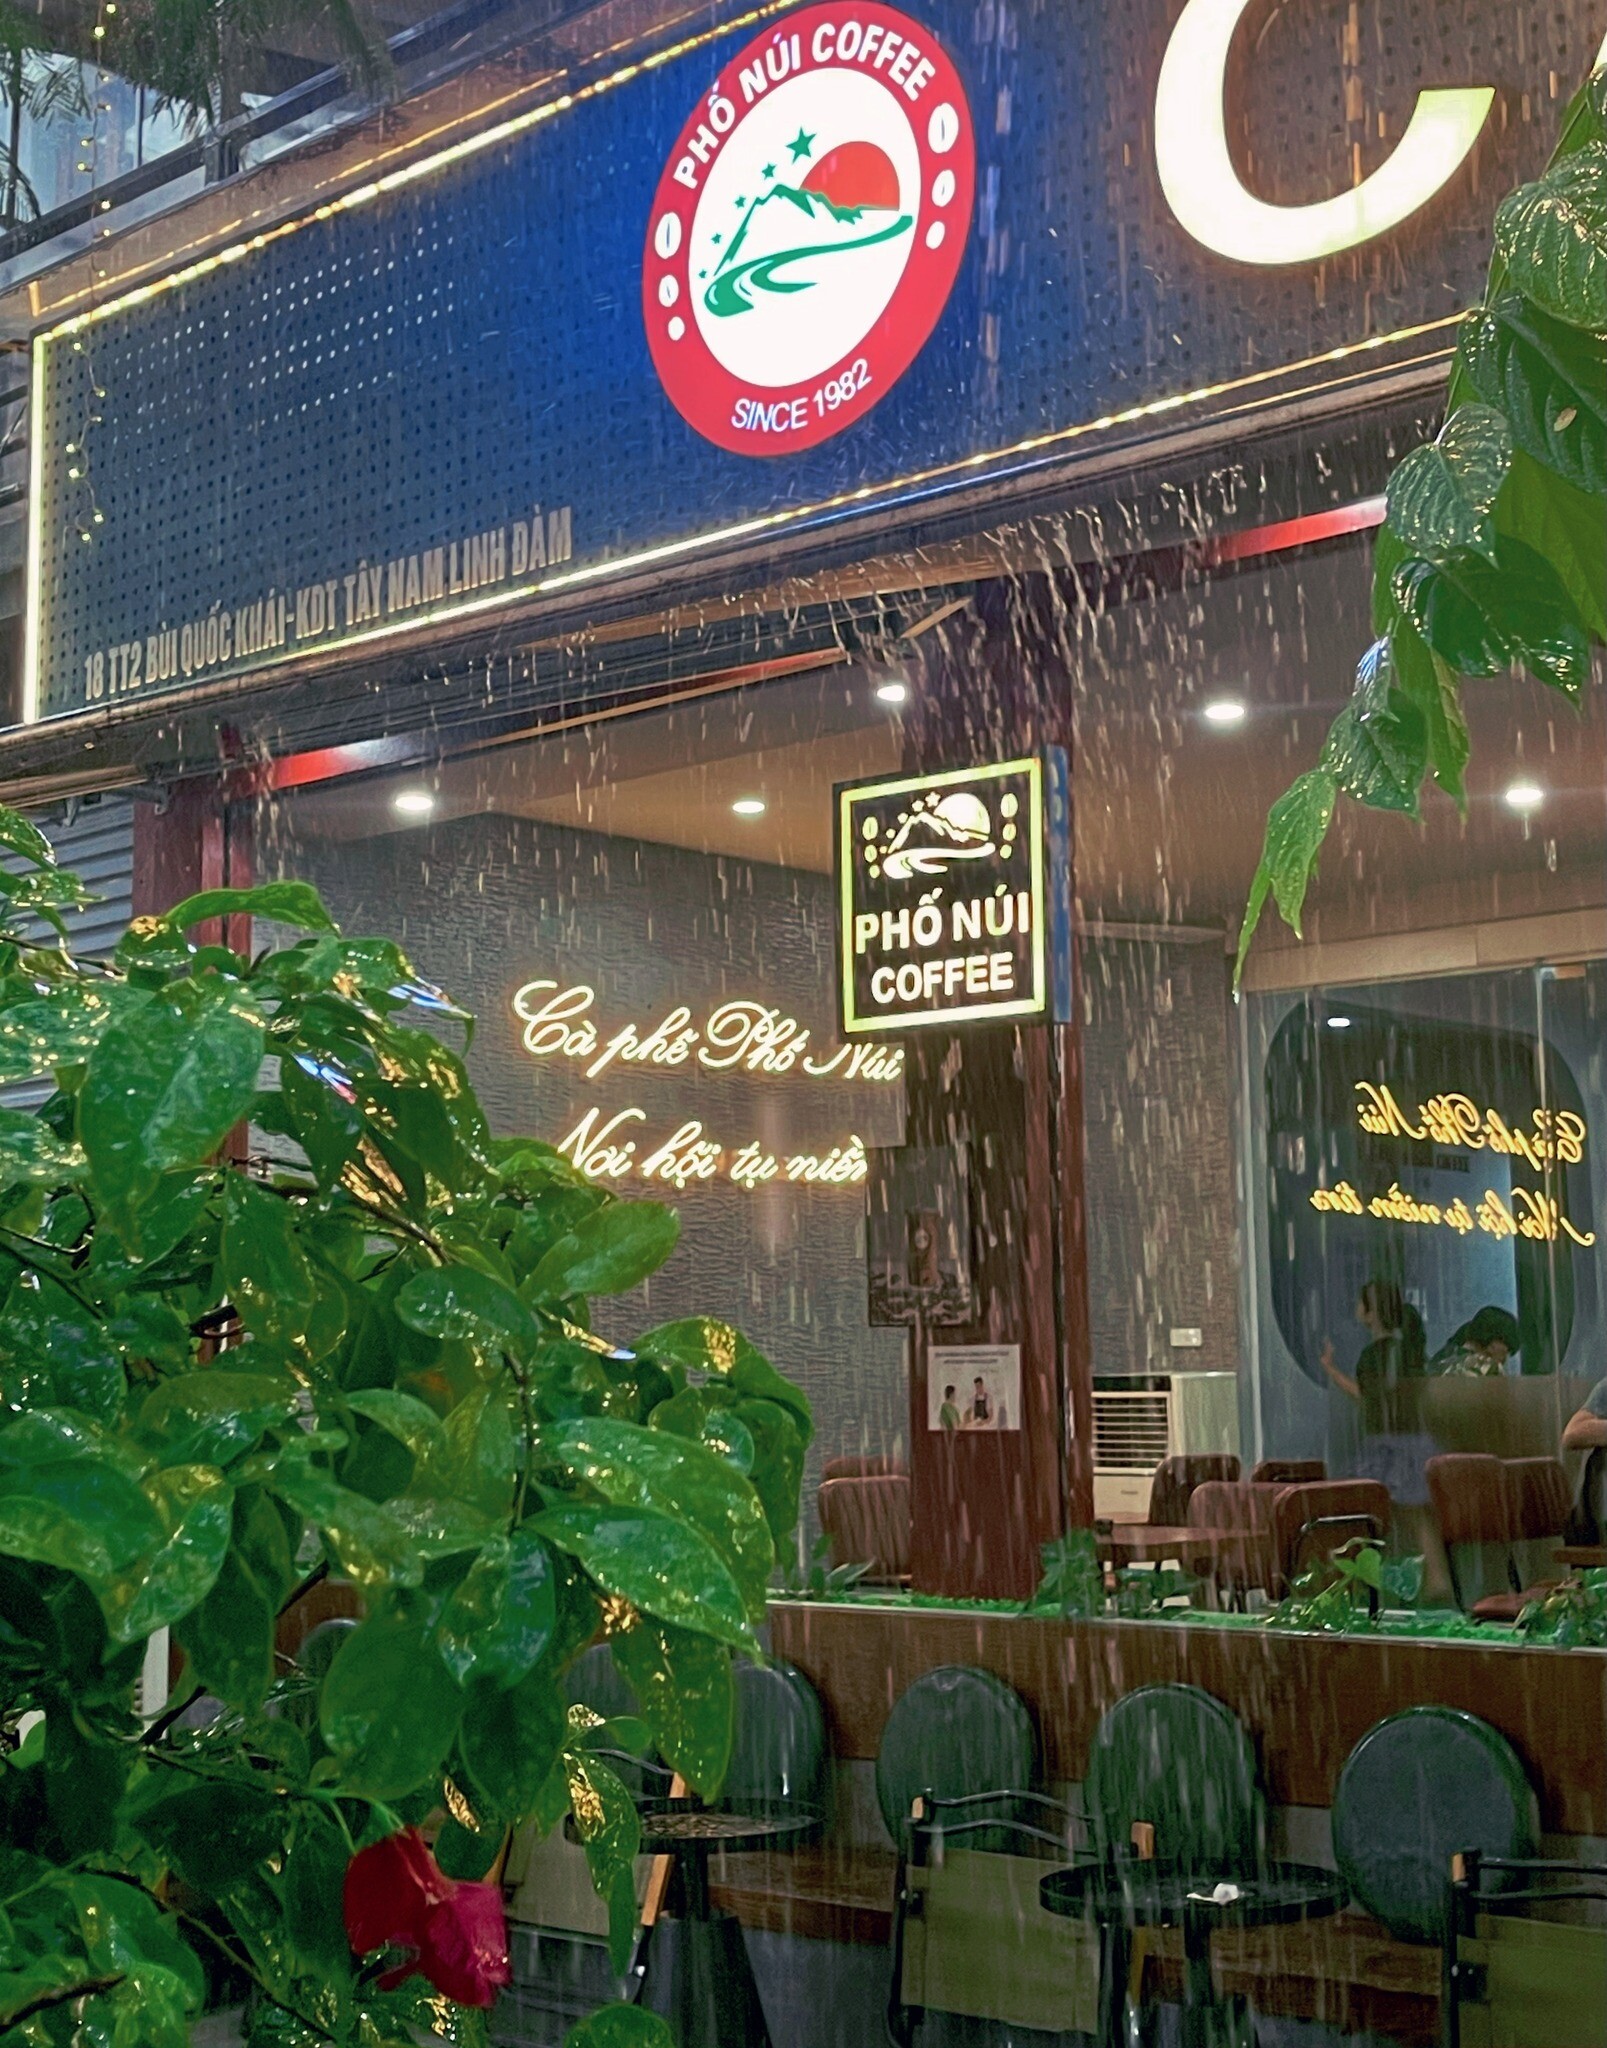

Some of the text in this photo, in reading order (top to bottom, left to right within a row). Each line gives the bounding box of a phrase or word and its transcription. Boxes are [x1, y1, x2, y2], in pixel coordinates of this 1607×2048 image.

[673, 21, 936, 189] PHỐ NÚI COFFEE
[731, 358, 873, 433] SINCE 1982
[84, 652, 104, 701] 18
[109, 641, 142, 694] TT2
[145, 621, 178, 684] BÙI
[181, 600, 232, 677] QUỐC
[343, 559, 383, 626] TÂY
[388, 546, 444, 613] NAM
[449, 526, 505, 595] LINH
[855, 883, 1029, 954] PHỐ NÚI
[871, 951, 1014, 1004] COFFEE
[513, 979, 598, 1055] Cà
[585, 1006, 700, 1078] phê
[698, 1000, 811, 1072] Phố
[640, 1120, 722, 1189] hội
[729, 1140, 780, 1189] tụ
